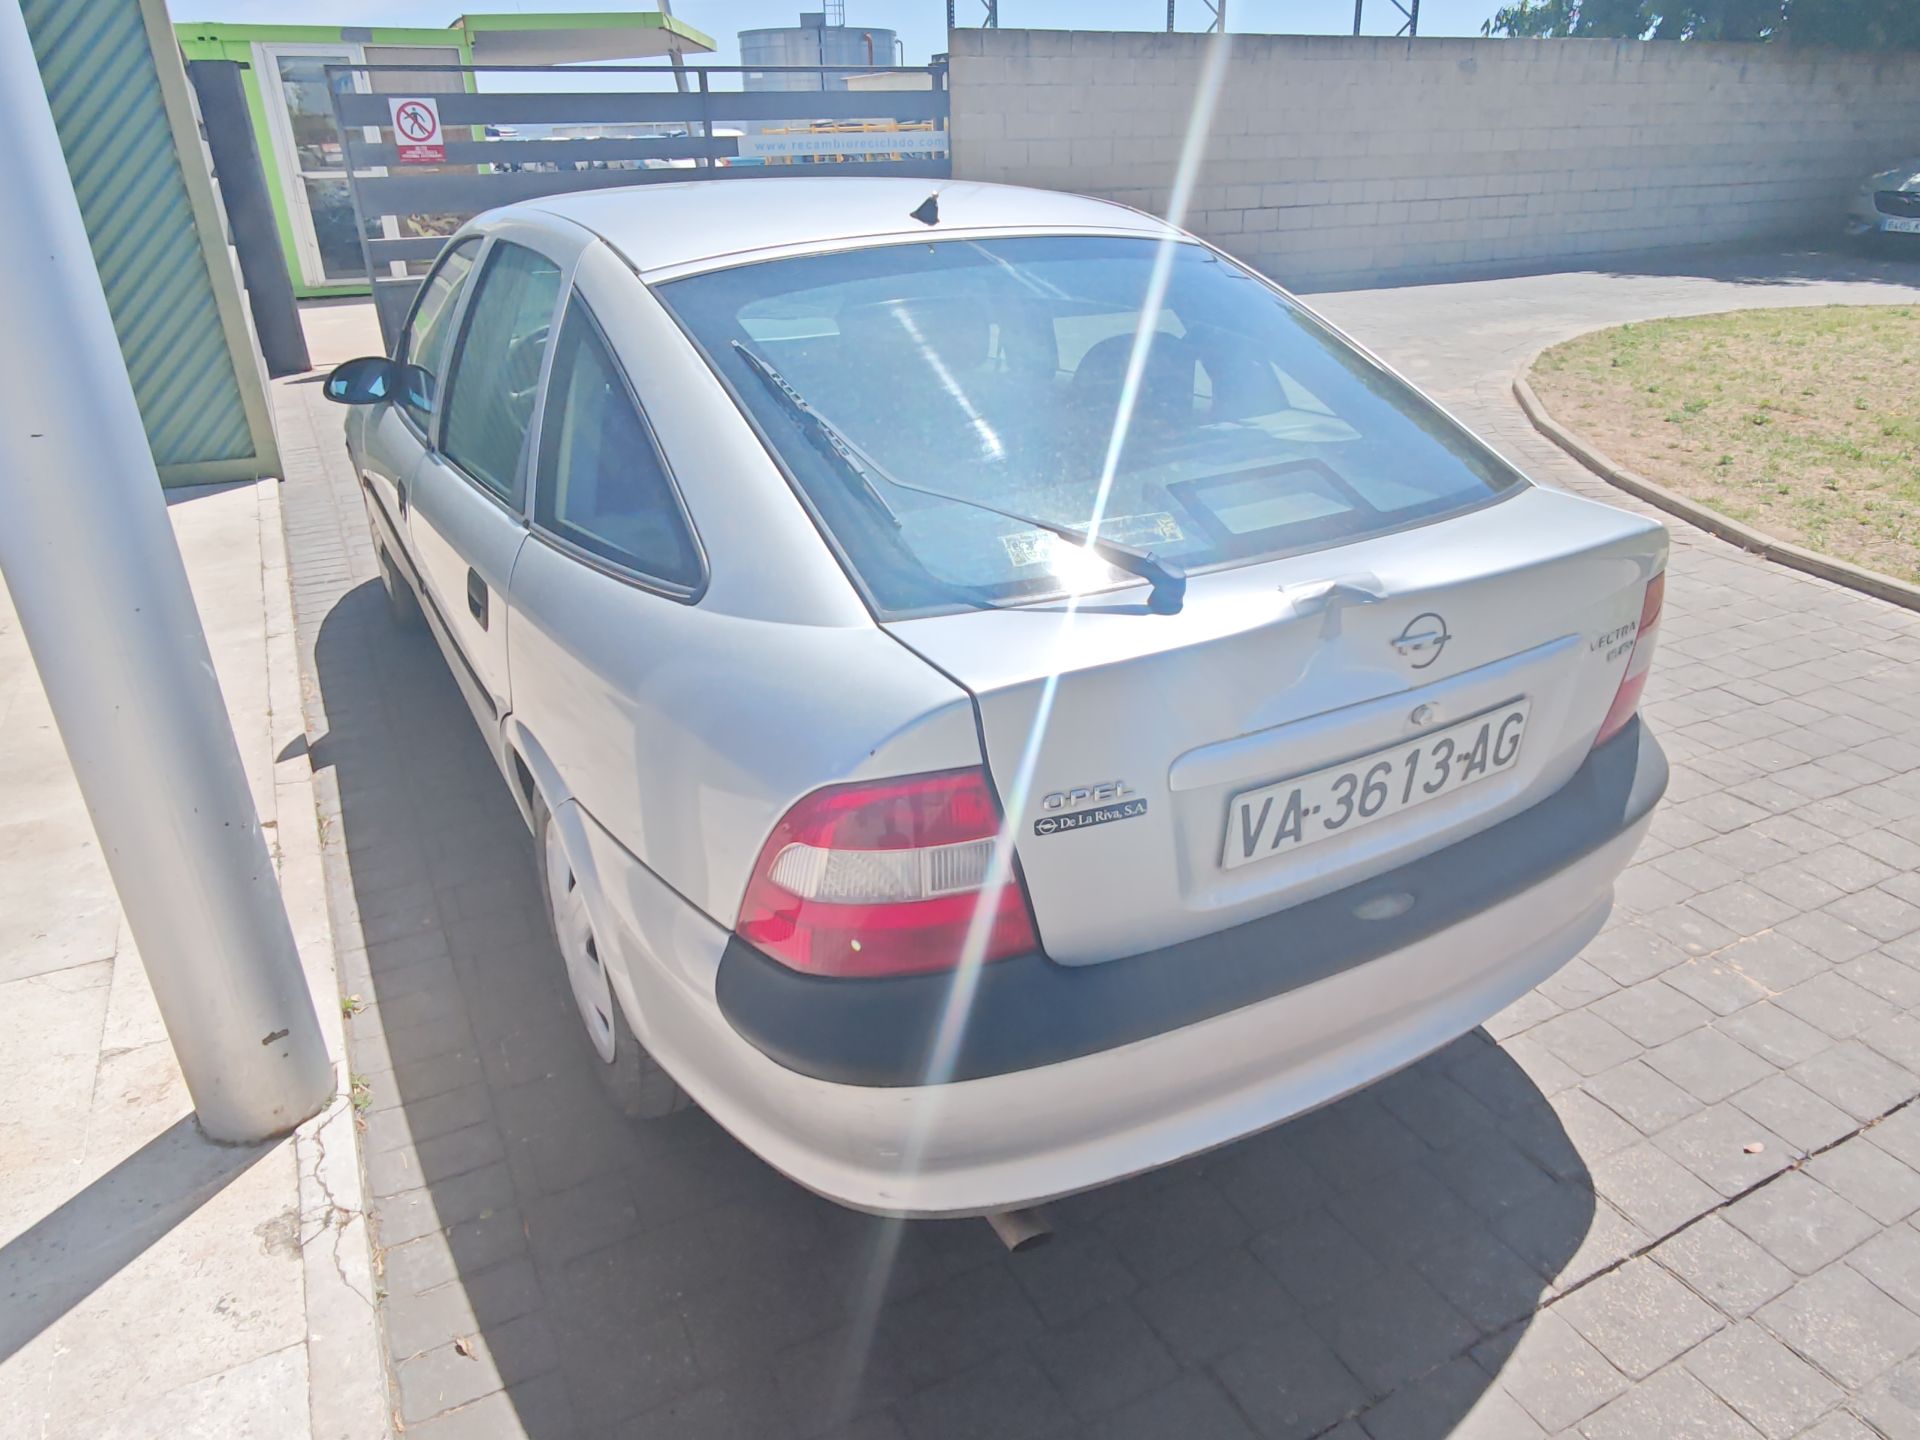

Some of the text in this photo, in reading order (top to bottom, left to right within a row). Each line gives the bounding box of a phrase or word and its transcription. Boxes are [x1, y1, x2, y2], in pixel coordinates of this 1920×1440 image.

[1042, 780, 1135, 812] OPEL
[1060, 818, 1076, 829] De
[1078, 815, 1093, 826] La
